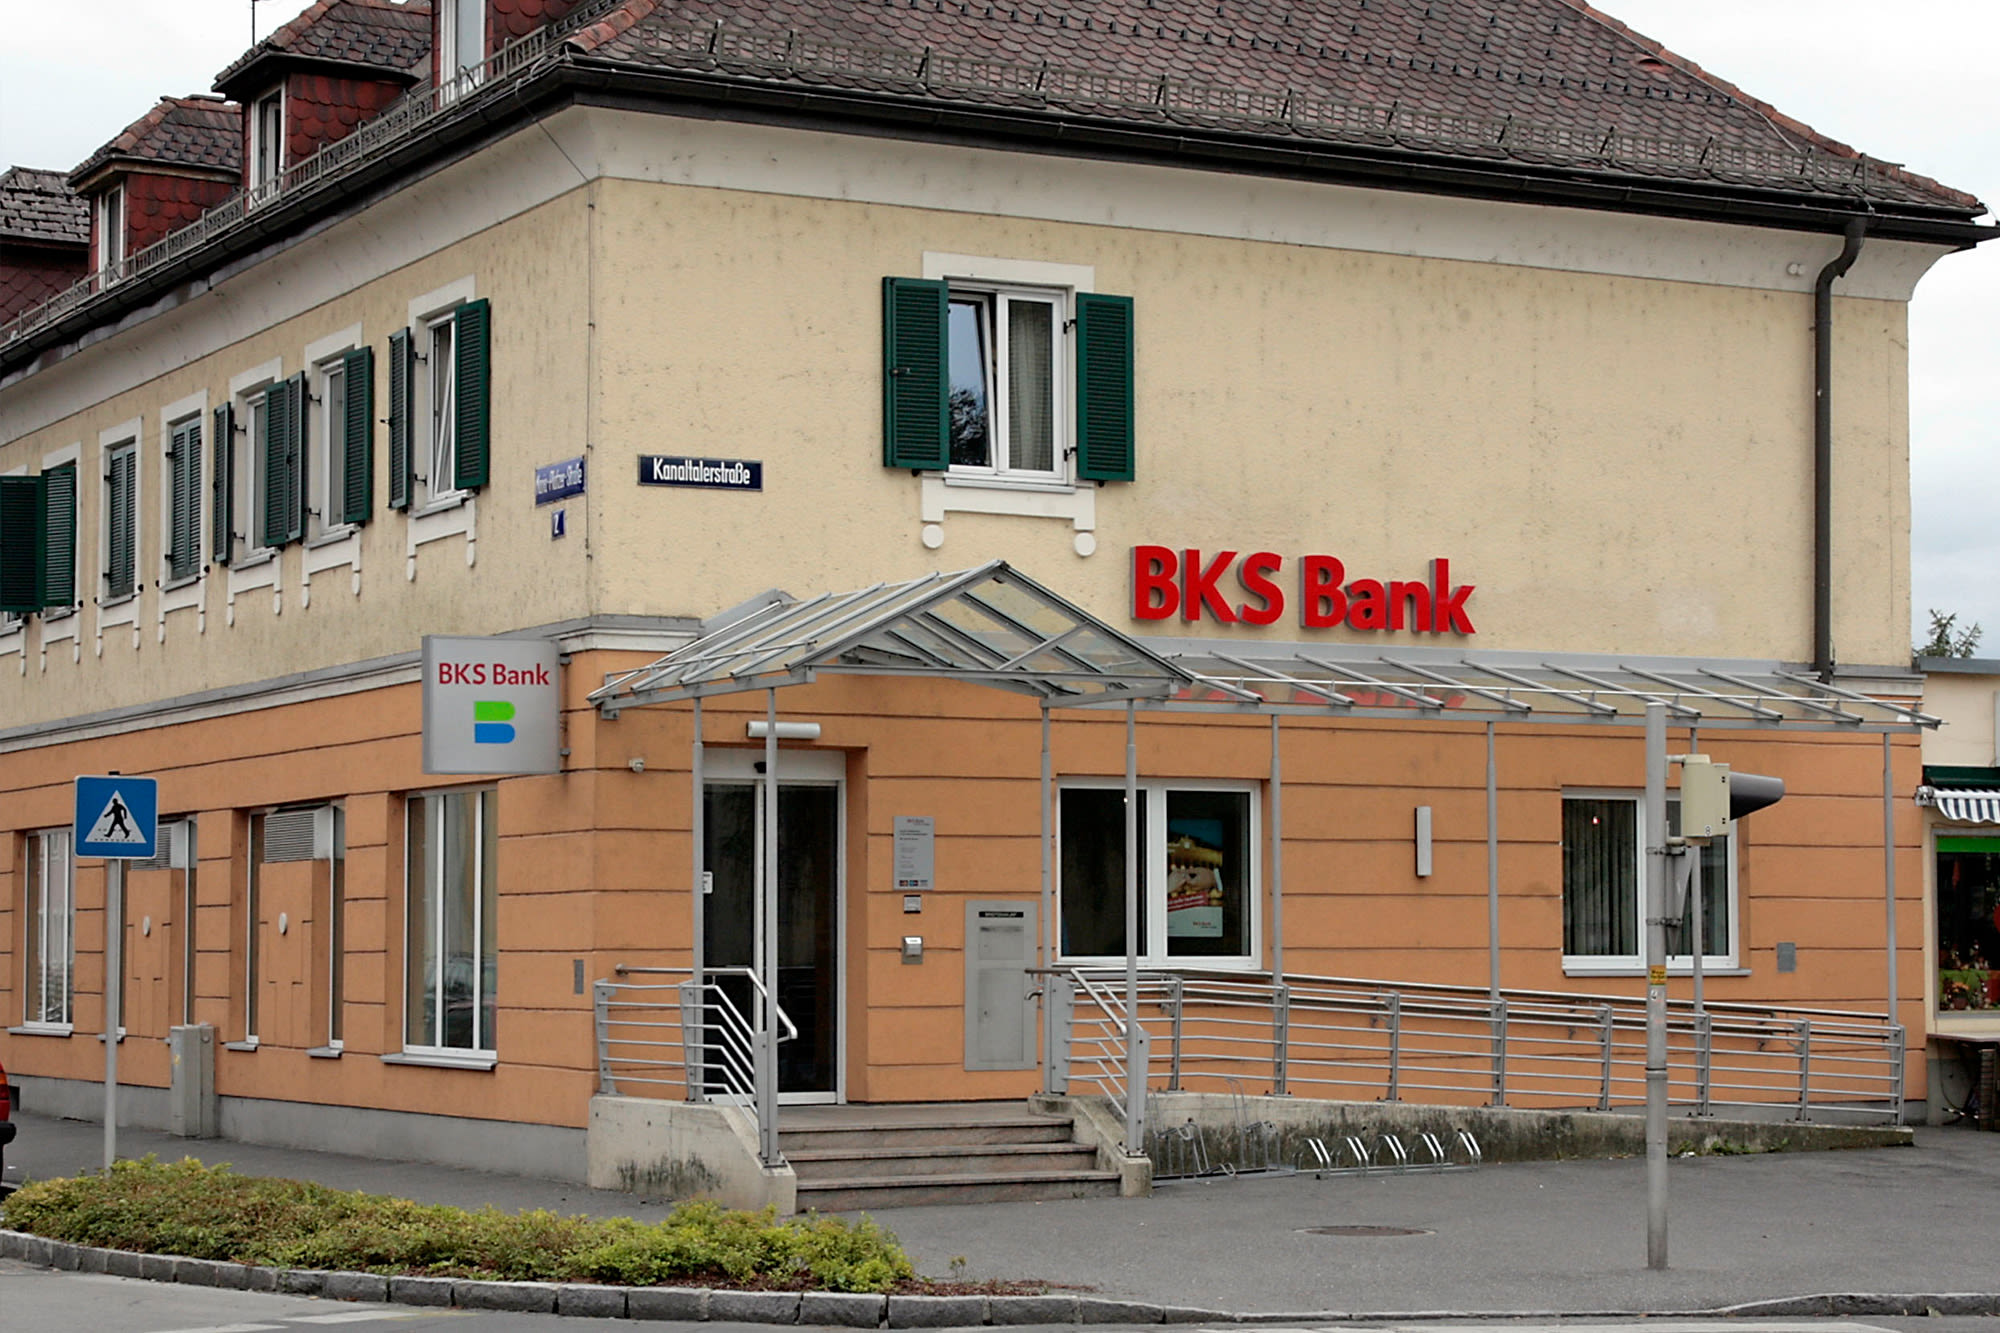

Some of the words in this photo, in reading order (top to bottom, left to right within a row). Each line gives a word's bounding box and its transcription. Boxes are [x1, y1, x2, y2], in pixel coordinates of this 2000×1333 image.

[653, 457, 751, 485] Kanaltalerstraße
[1131, 545, 1285, 626] BKS
[1299, 555, 1476, 635] Bank
[439, 662, 487, 685] BKS
[493, 662, 550, 686] Bank
